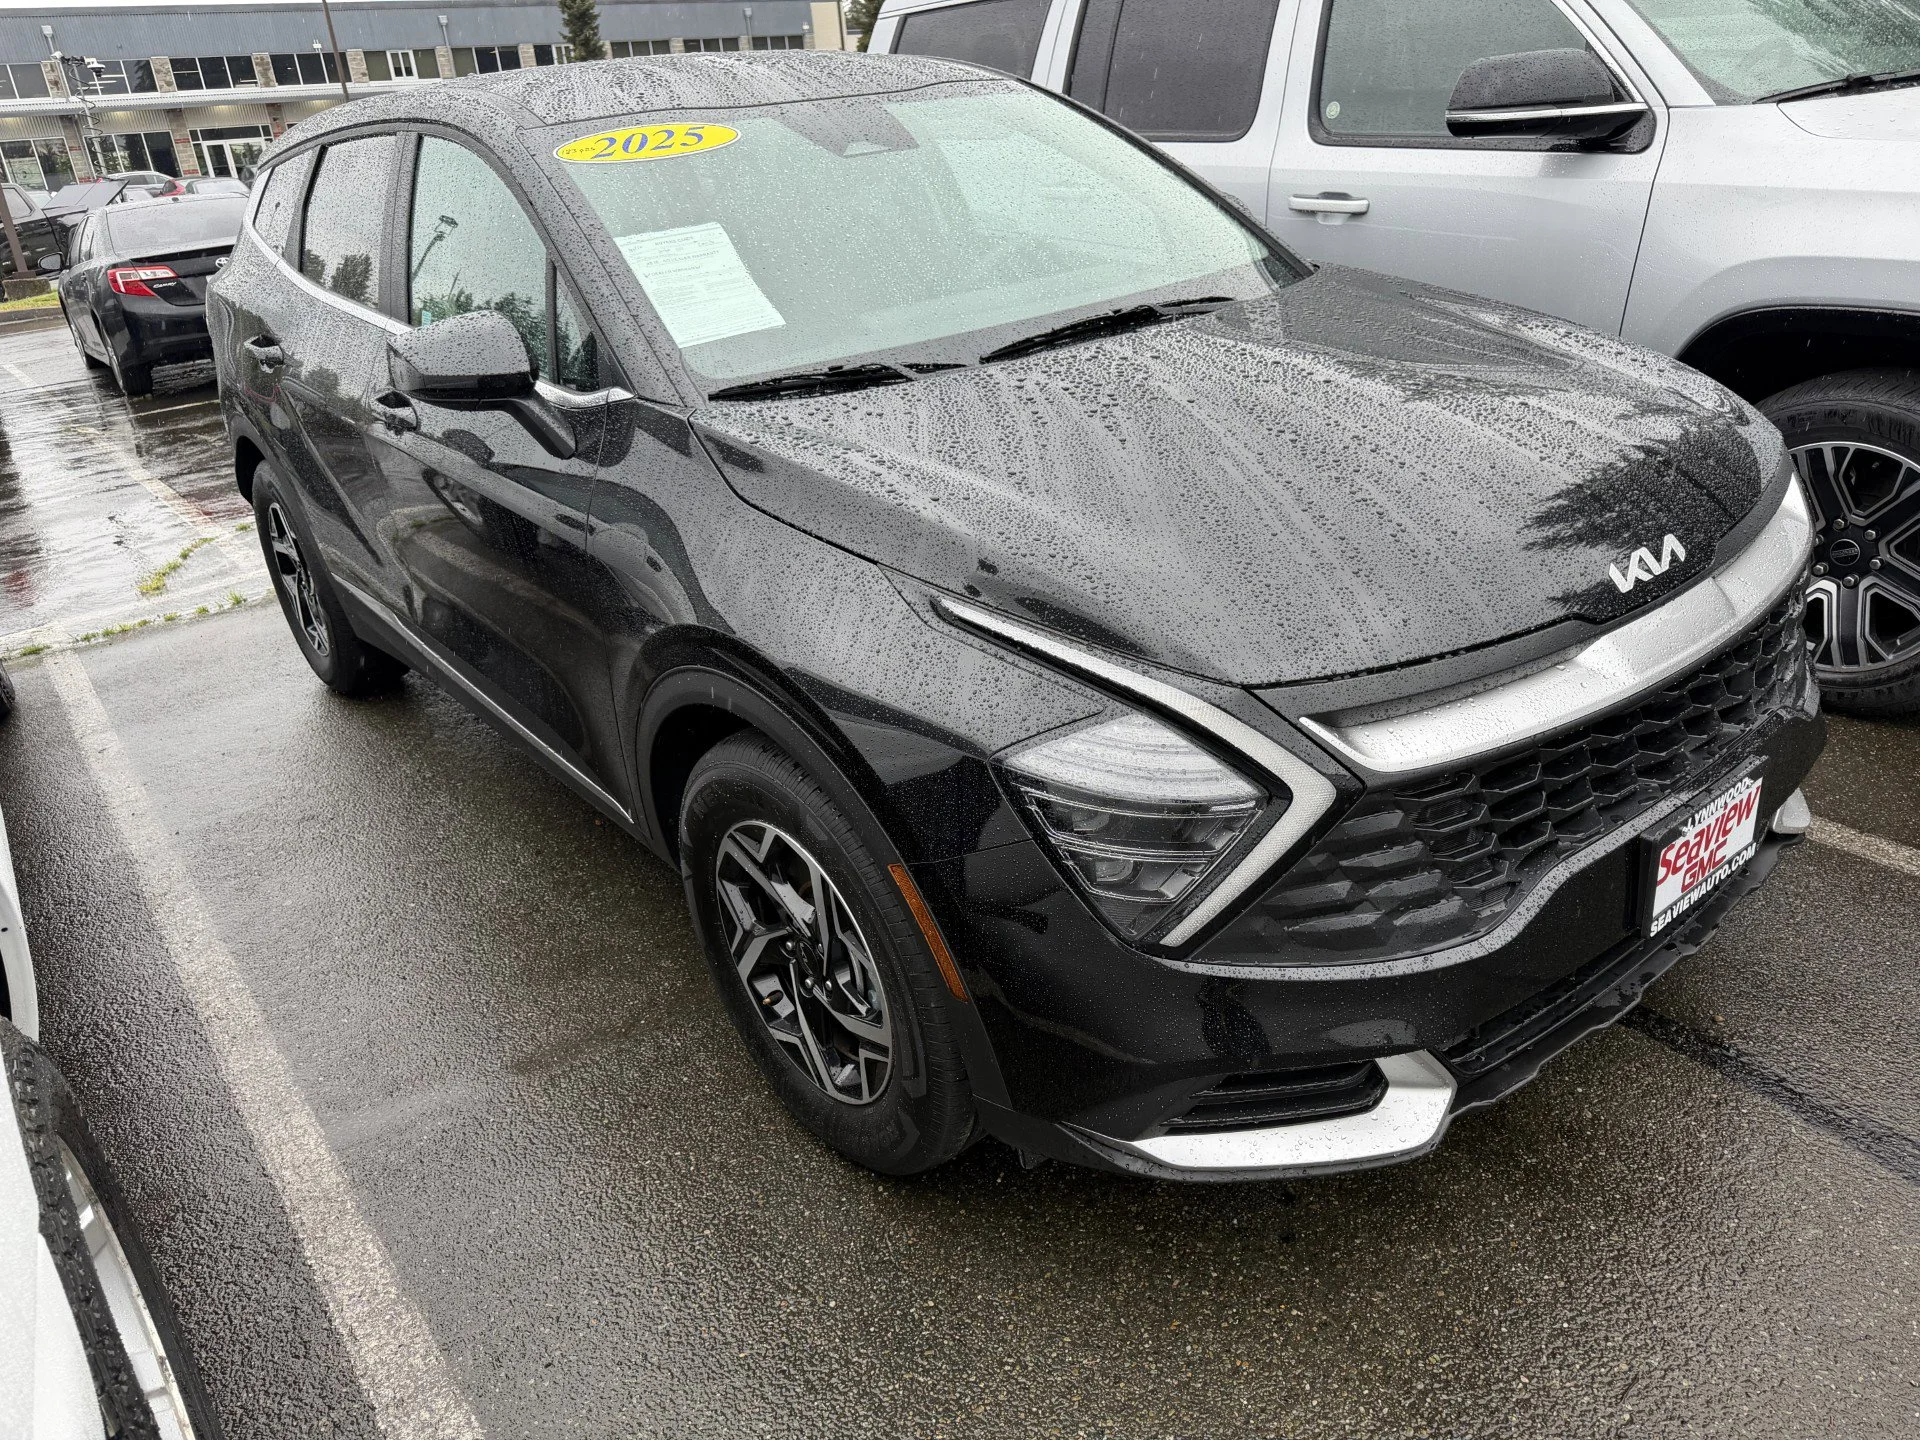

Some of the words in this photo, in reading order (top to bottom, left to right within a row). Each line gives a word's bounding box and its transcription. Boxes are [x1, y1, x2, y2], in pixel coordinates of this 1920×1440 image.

[591, 126, 705, 159] 2025
[1609, 534, 1686, 593] KIA
[1686, 777, 1751, 832] LYNNWOOD
[1650, 843, 1757, 937] SEAVIEWAUTO.COM
[1681, 838, 1727, 893] GMC
